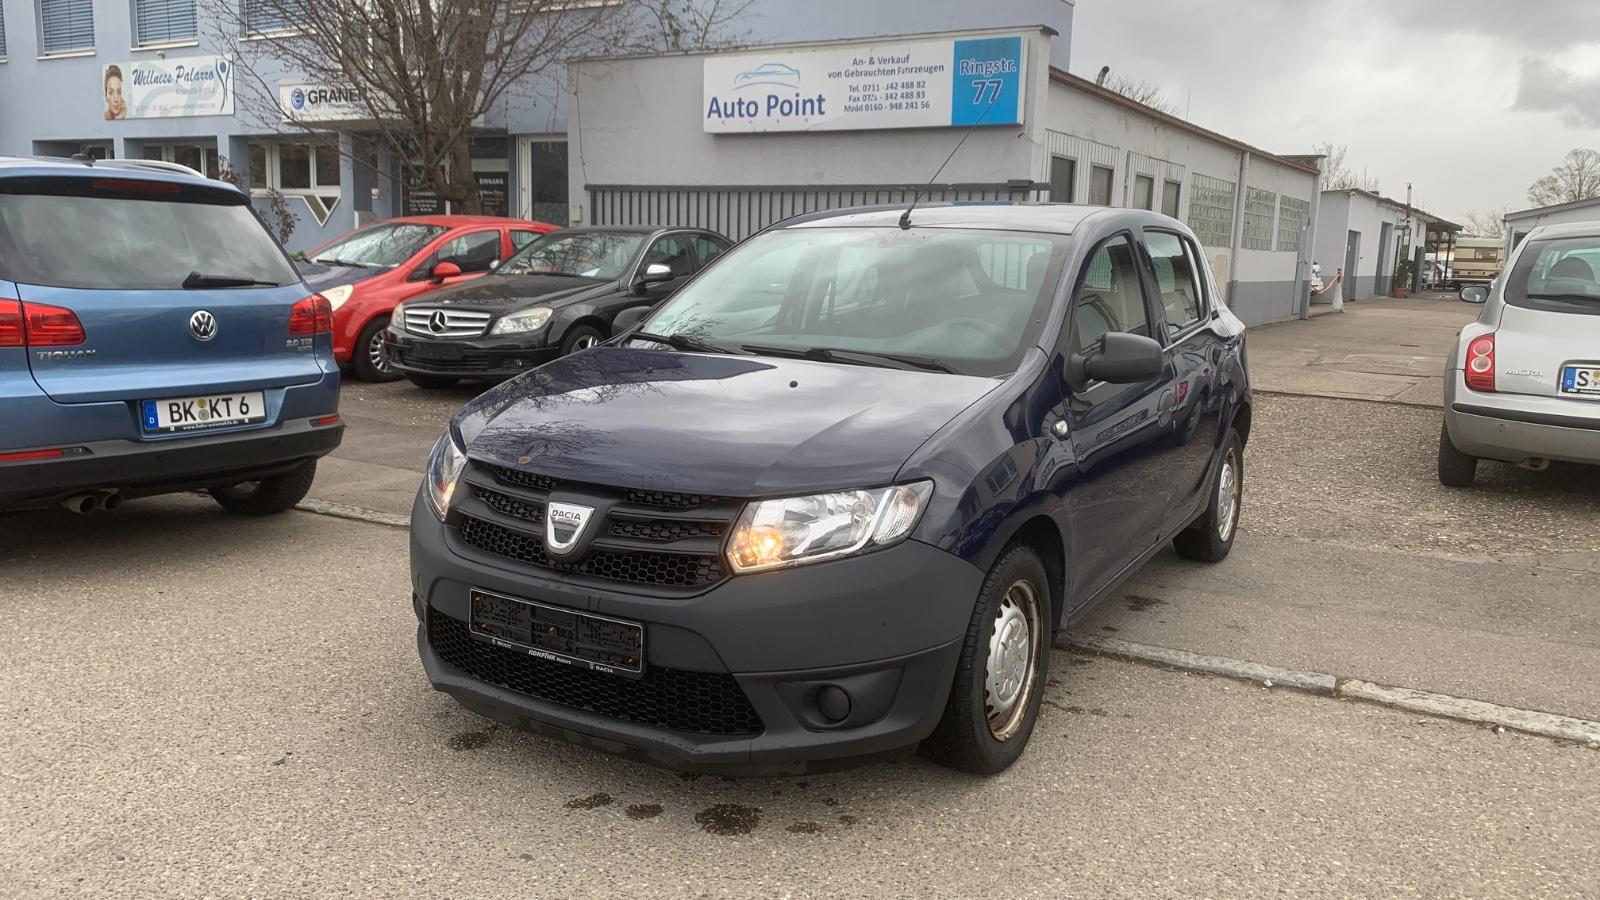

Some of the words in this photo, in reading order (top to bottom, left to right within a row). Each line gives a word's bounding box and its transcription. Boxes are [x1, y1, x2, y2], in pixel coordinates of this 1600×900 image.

[852, 57, 866, 66] An-
[868, 56, 875, 65] &
[877, 54, 910, 65] Verkauf
[959, 57, 1017, 75] Ringstr.
[132, 68, 173, 86] Wellness
[175, 64, 214, 84] Palazzo
[828, 71, 842, 79] von
[844, 67, 896, 78] Gebrauchten
[849, 84, 861, 93] Tel.
[862, 84, 880, 92] 0711
[900, 81, 915, 90] 488
[916, 80, 926, 89] 82
[971, 79, 1003, 104] 77
[848, 94, 860, 103] Fax
[884, 92, 898, 101] 342
[900, 91, 914, 100] 488
[916, 90, 926, 99] 83
[707, 97, 759, 119] Auto
[766, 92, 826, 117] Point
[864, 102, 883, 112] 0160
[889, 102, 903, 110] 948
[904, 101, 918, 110] 241
[920, 100, 930, 109] 56
[1577, 370, 1590, 387] S
[168, 401, 197, 423] BK
[208, 397, 233, 419] KT
[239, 396, 250, 415] 6
[552, 509, 581, 521] DACIA
